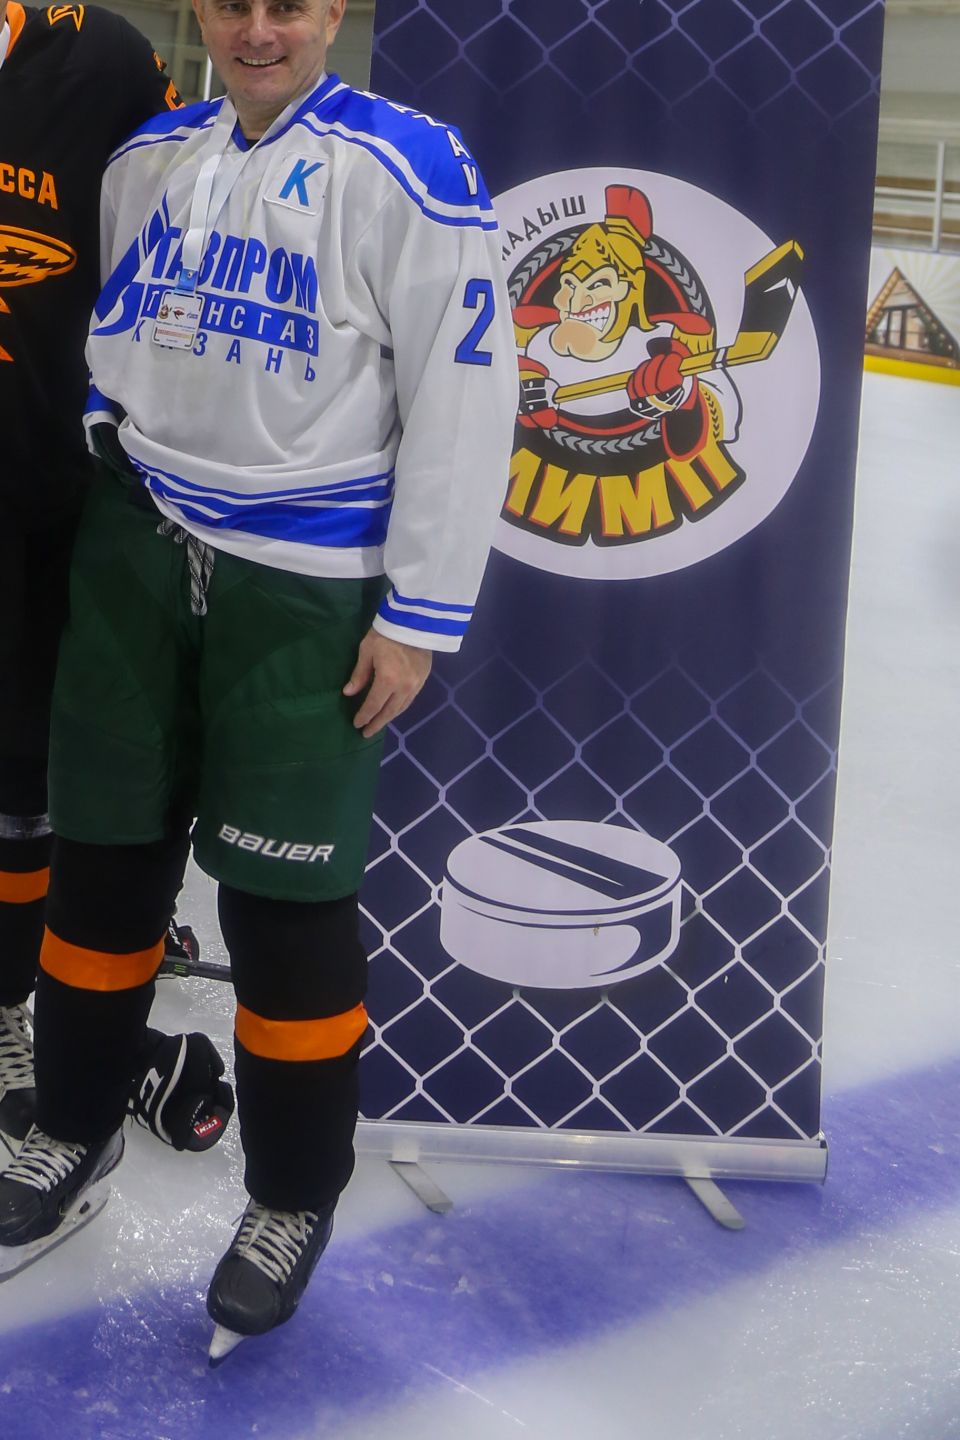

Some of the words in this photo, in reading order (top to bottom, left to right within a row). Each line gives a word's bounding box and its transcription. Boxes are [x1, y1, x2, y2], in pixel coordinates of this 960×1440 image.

[279, 158, 325, 207] К
[501, 195, 586, 261] АДЫШ
[132, 320, 316, 382] КЗАНЬ
[147, 290, 315, 350] ТНСГАЗ
[504, 443, 738, 537] ЛИМП
